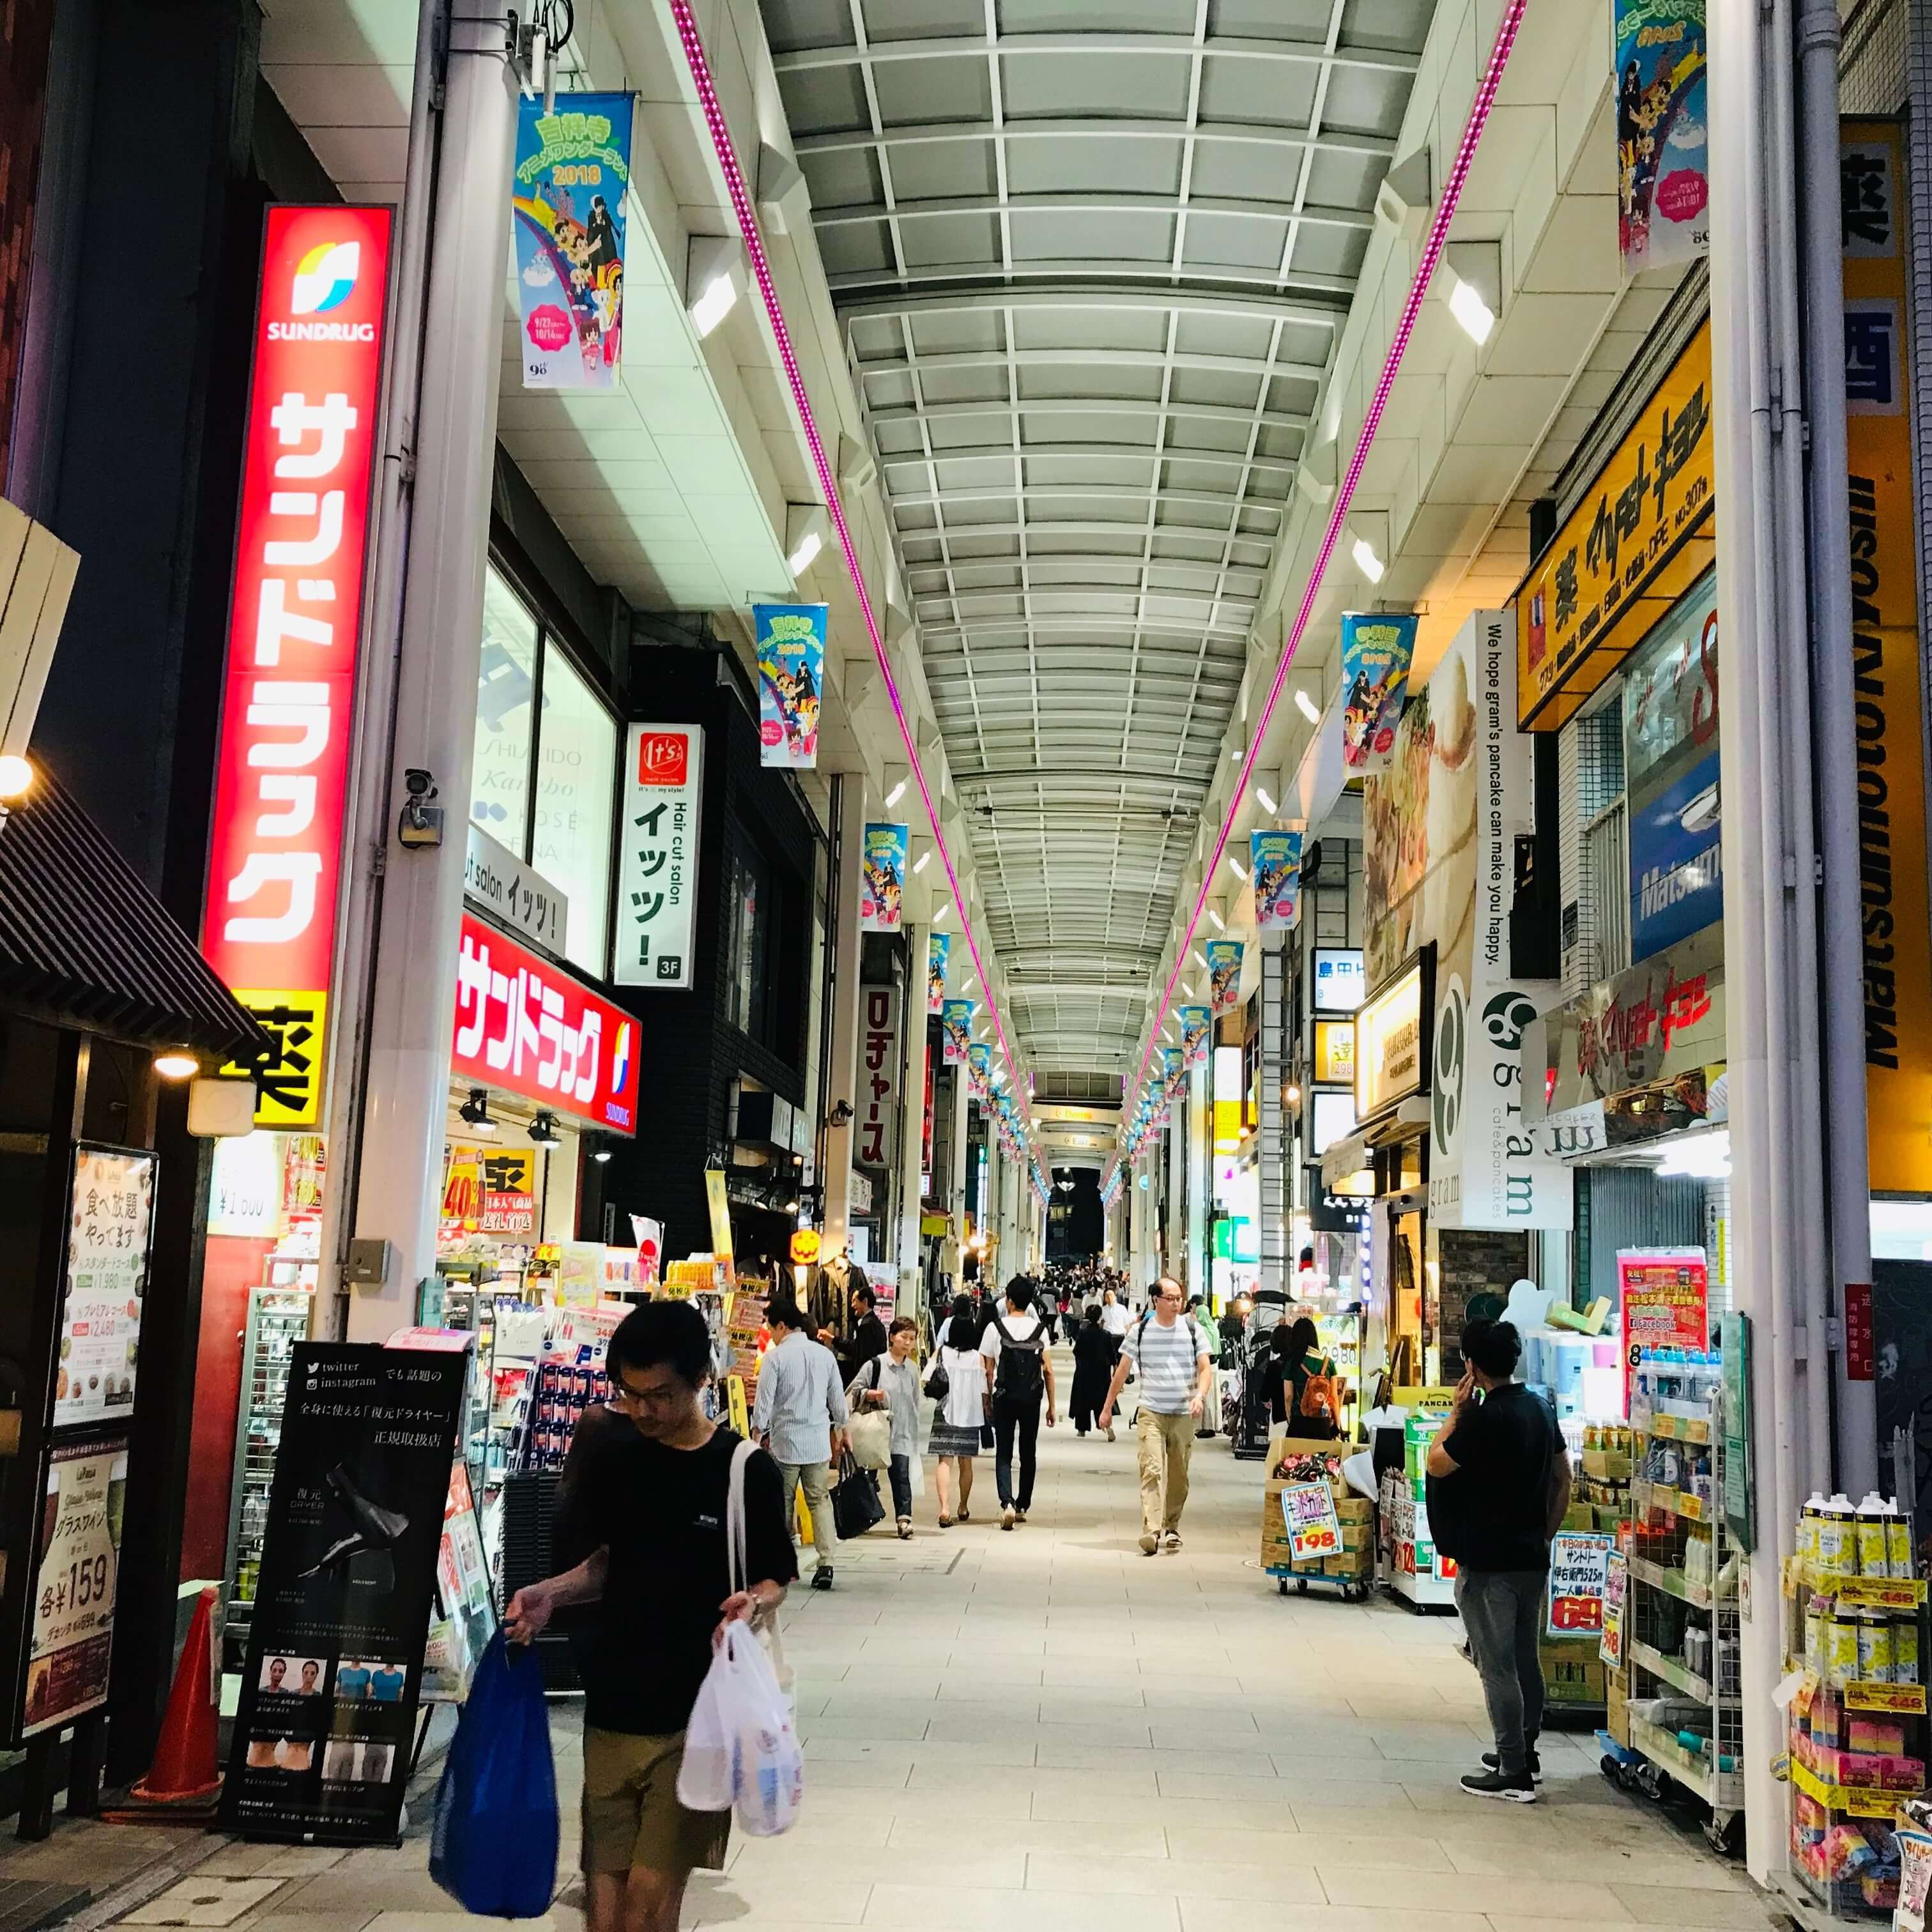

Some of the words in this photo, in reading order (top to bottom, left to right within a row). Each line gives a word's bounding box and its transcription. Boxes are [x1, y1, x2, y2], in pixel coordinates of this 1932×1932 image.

[535, 113, 611, 144] 吉祥寺
[553, 165, 601, 185] 2018
[268, 323, 374, 341] SUNDRUG
[1488, 624, 1502, 646] We
[225, 392, 358, 942] サンドラッグ
[1487, 649, 1502, 688] hope
[1486, 692, 1502, 740] gram's
[476, 739, 582, 767] SHIIDO
[481, 769, 574, 797] Kabo
[1487, 745, 1503, 806] pancake
[673, 802, 687, 832] Hair
[1491, 811, 1503, 836] can
[672, 836, 686, 859] cut
[1491, 840, 1503, 880] make
[475, 863, 502, 901] salon
[669, 861, 685, 906] salon
[1487, 885, 1501, 913] you
[1488, 917, 1504, 967] happy.
[661, 960, 678, 975] 3F
[456, 935, 602, 1104] サンドラッグ
[1492, 1107, 1505, 1219] cafe&pancakes
[85, 1187, 139, 1220] 食べ放題
[1430, 1174, 1459, 1220] gram
[85, 1221, 135, 1248] やってます
[1638, 1319, 1676, 1330] Facebook
[323, 1361, 360, 1372] twitter
[386, 1368, 442, 1382] でも話題の
[321, 1377, 376, 1388] instagram
[373, 1430, 441, 1448] 正規取扱店
[297, 1487, 321, 1500] 復元
[56, 1510, 107, 1540] グラスワイン
[1294, 1531, 1336, 1552] 198
[1567, 1550, 1597, 1564] サントリー
[1551, 1597, 1603, 1630] 69
